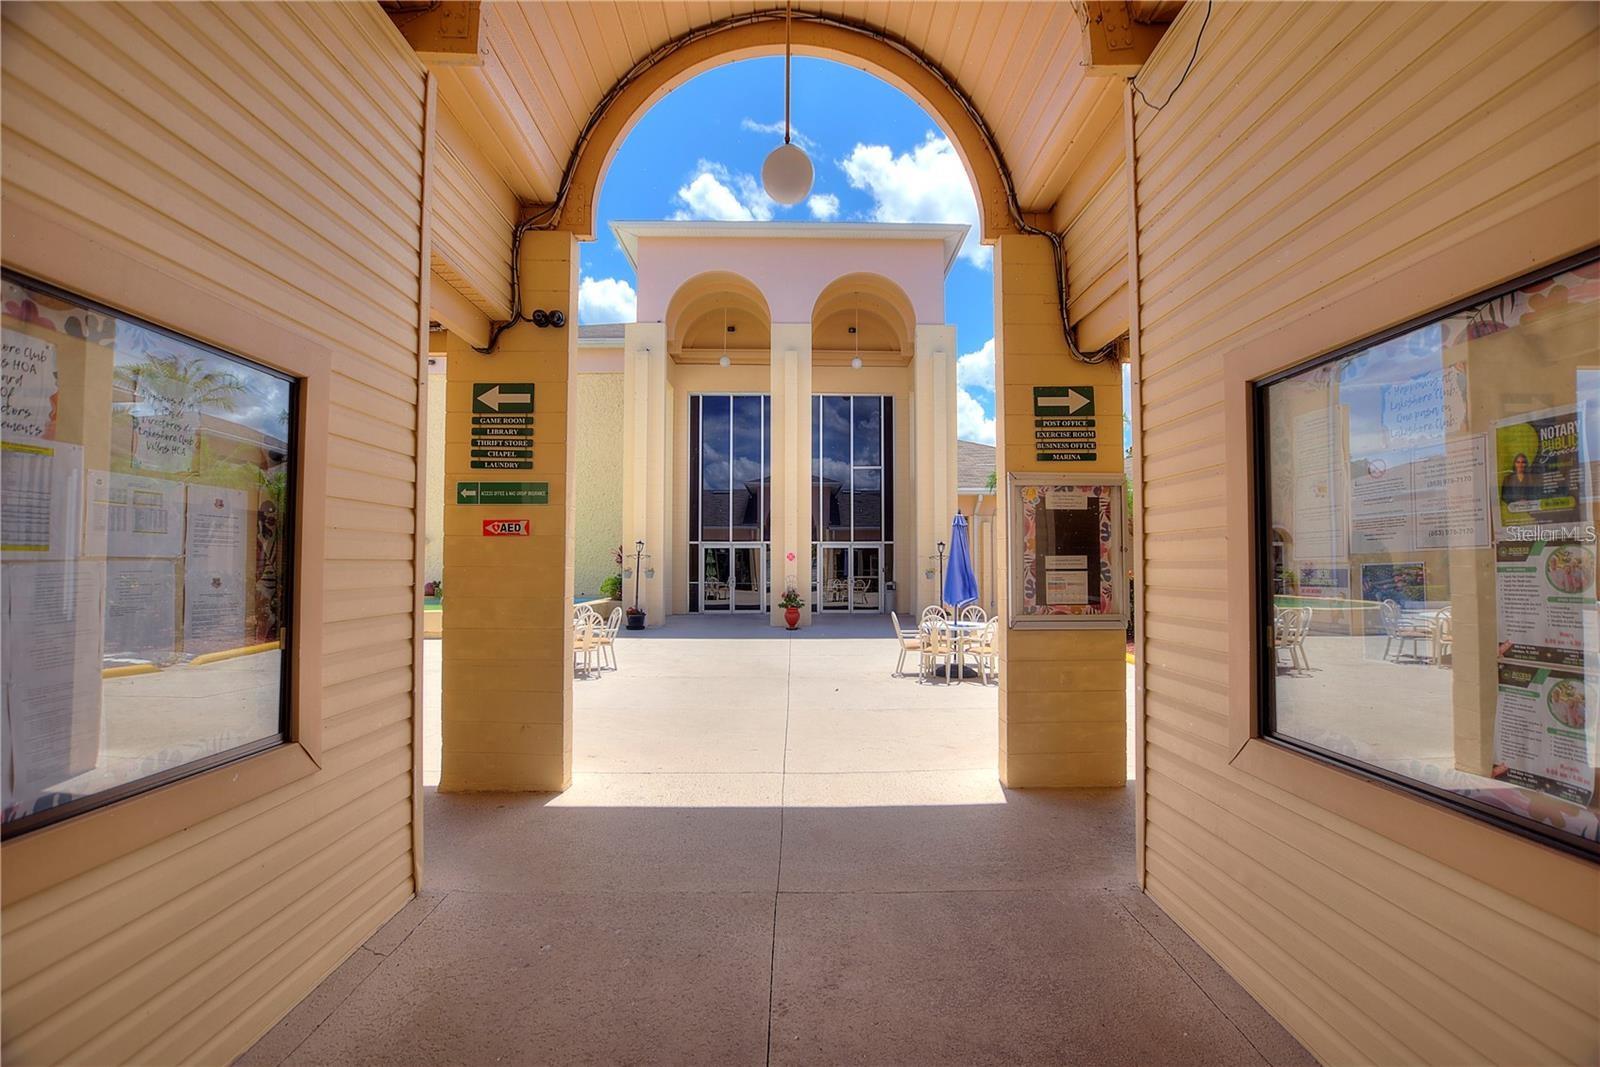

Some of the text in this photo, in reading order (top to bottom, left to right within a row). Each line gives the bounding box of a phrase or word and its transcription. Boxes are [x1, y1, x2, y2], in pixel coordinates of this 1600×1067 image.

[23, 346, 47, 362] Club
[12, 359, 37, 375] HOA
[1542, 433, 1579, 451] PUBLIC
[500, 523, 521, 532] AED
